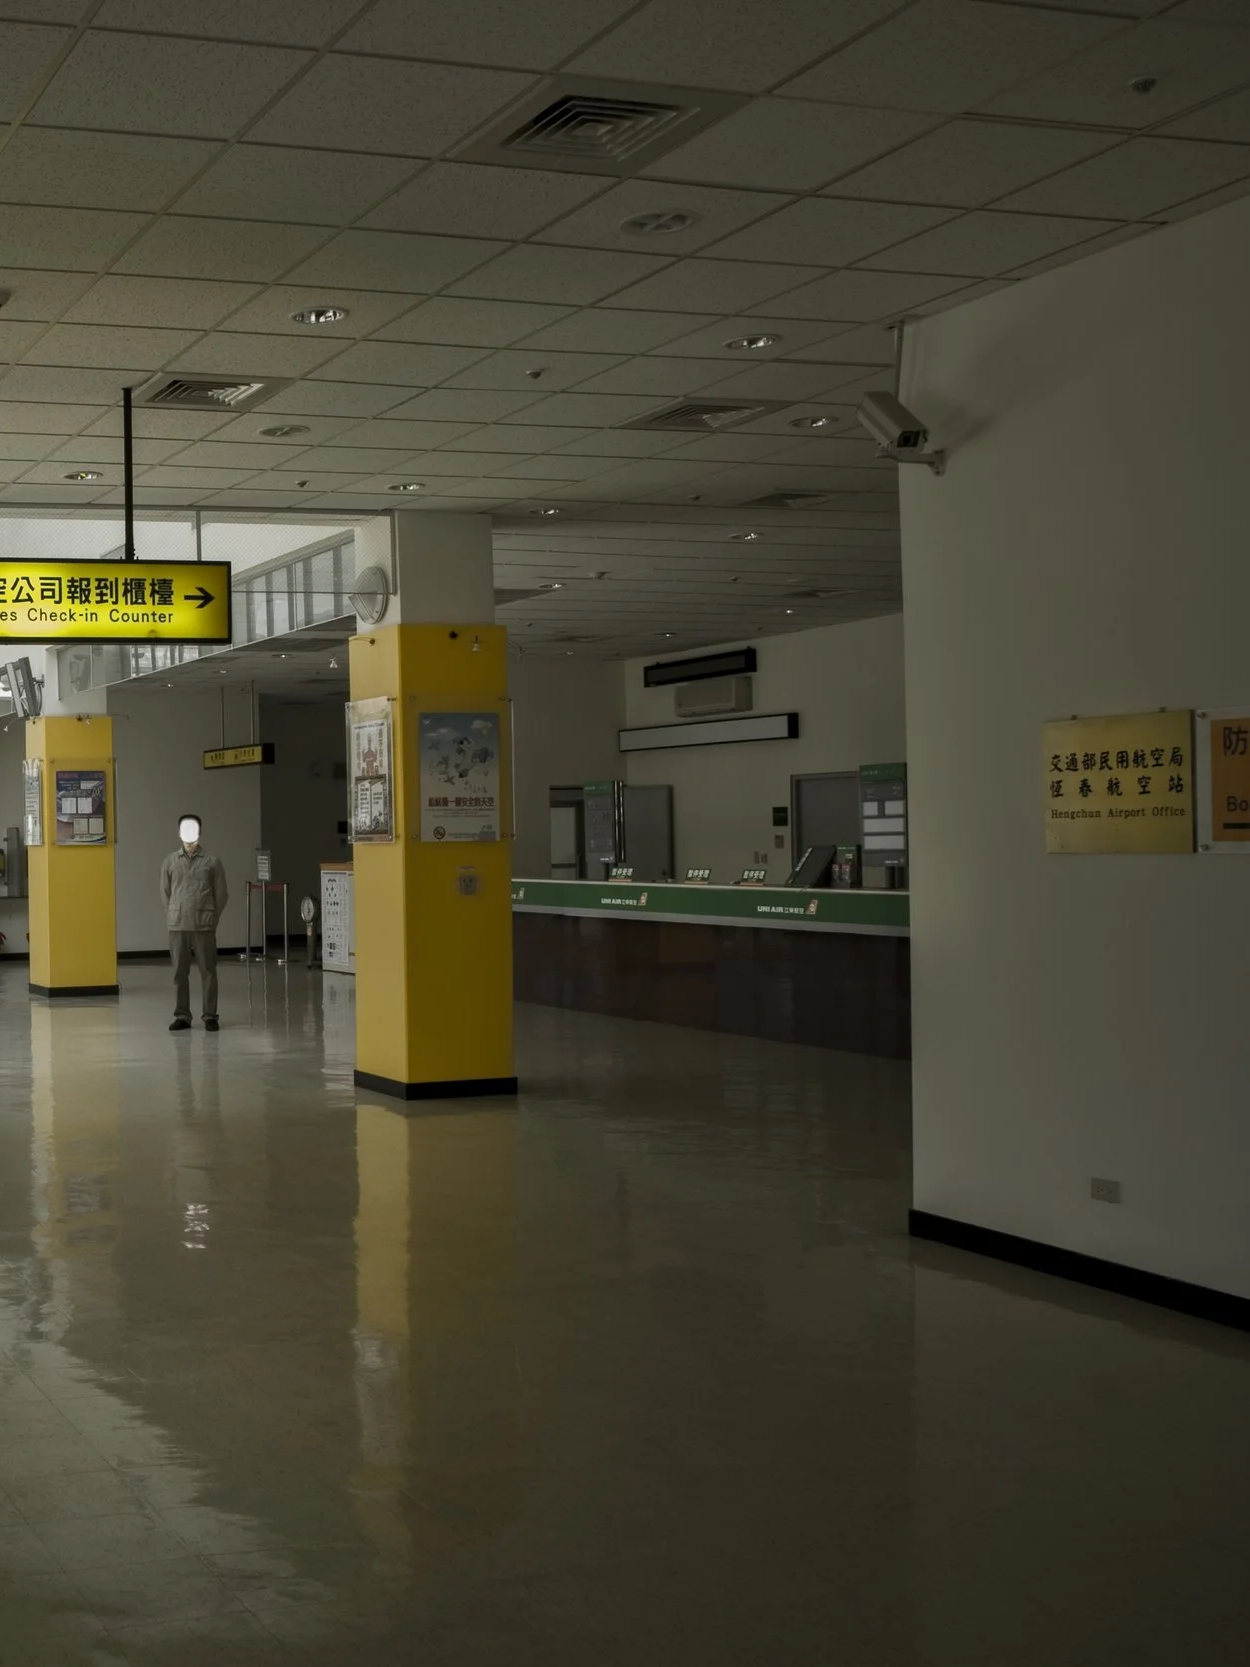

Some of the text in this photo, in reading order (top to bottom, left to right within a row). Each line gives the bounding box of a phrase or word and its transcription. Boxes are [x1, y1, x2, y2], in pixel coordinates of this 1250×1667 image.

[27, 608, 98, 622] Check-in
[109, 608, 174, 623] Counter
[1223, 725, 1249, 757] 防
[1049, 746, 1184, 773] 交通部民用航空局
[1049, 774, 1184, 799] 恆春航空站
[1051, 806, 1186, 820] Hengchun Airport Office
[757, 905, 771, 913] UNI
